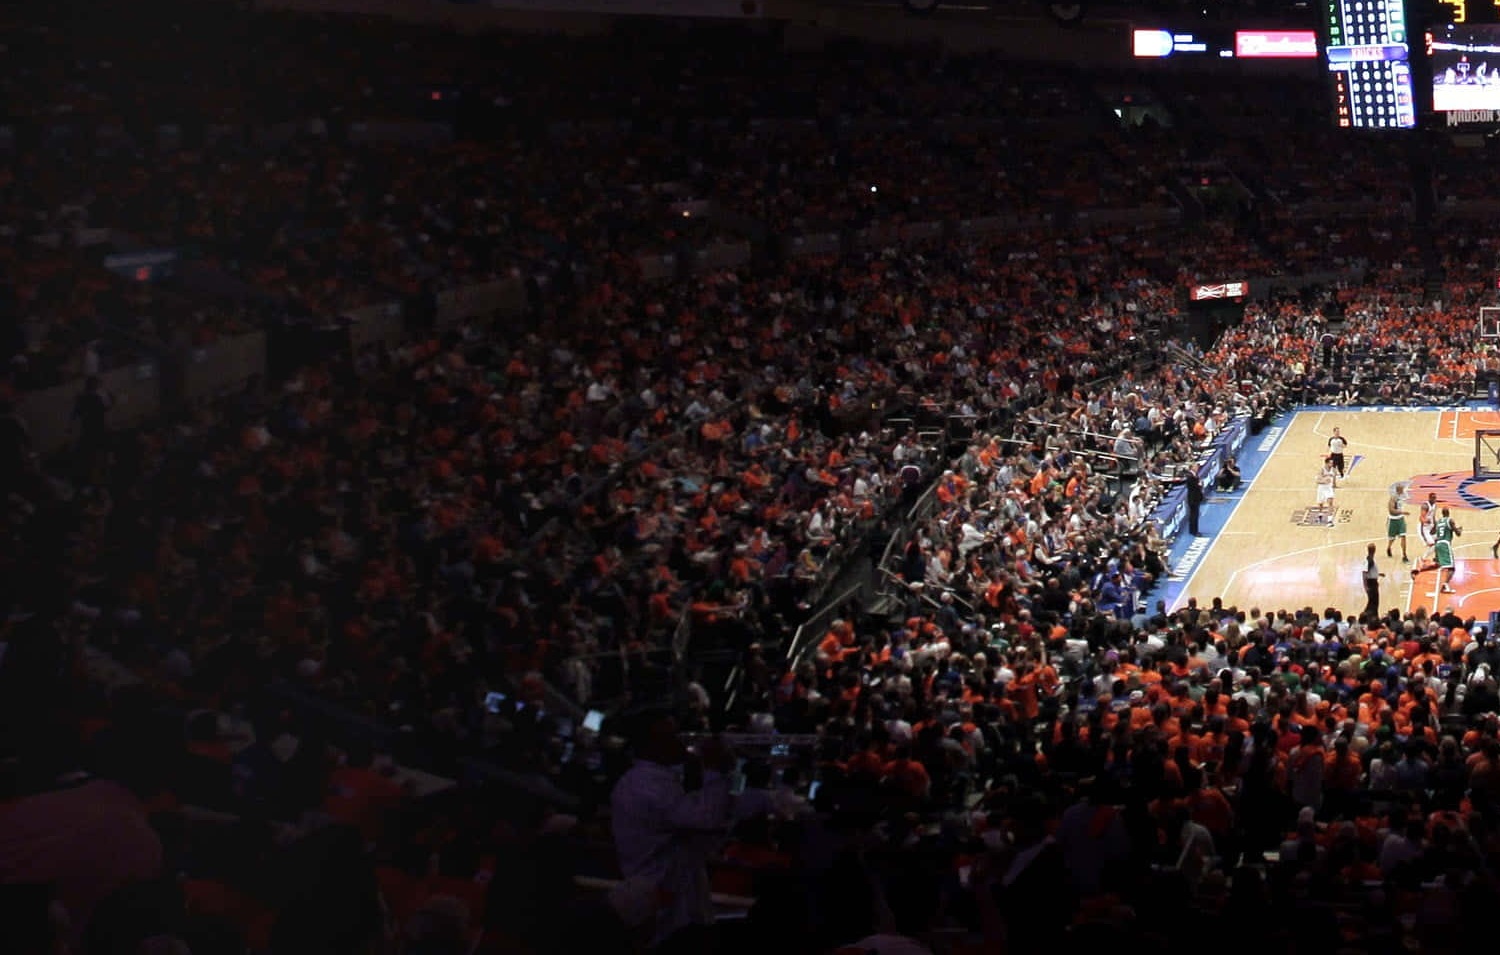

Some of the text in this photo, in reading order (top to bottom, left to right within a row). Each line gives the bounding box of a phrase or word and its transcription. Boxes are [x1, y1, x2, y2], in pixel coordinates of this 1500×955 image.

[1454, 1, 1465, 22] 3
[1447, 109, 1494, 126] MADISON
[1439, 526, 1445, 537] 5
